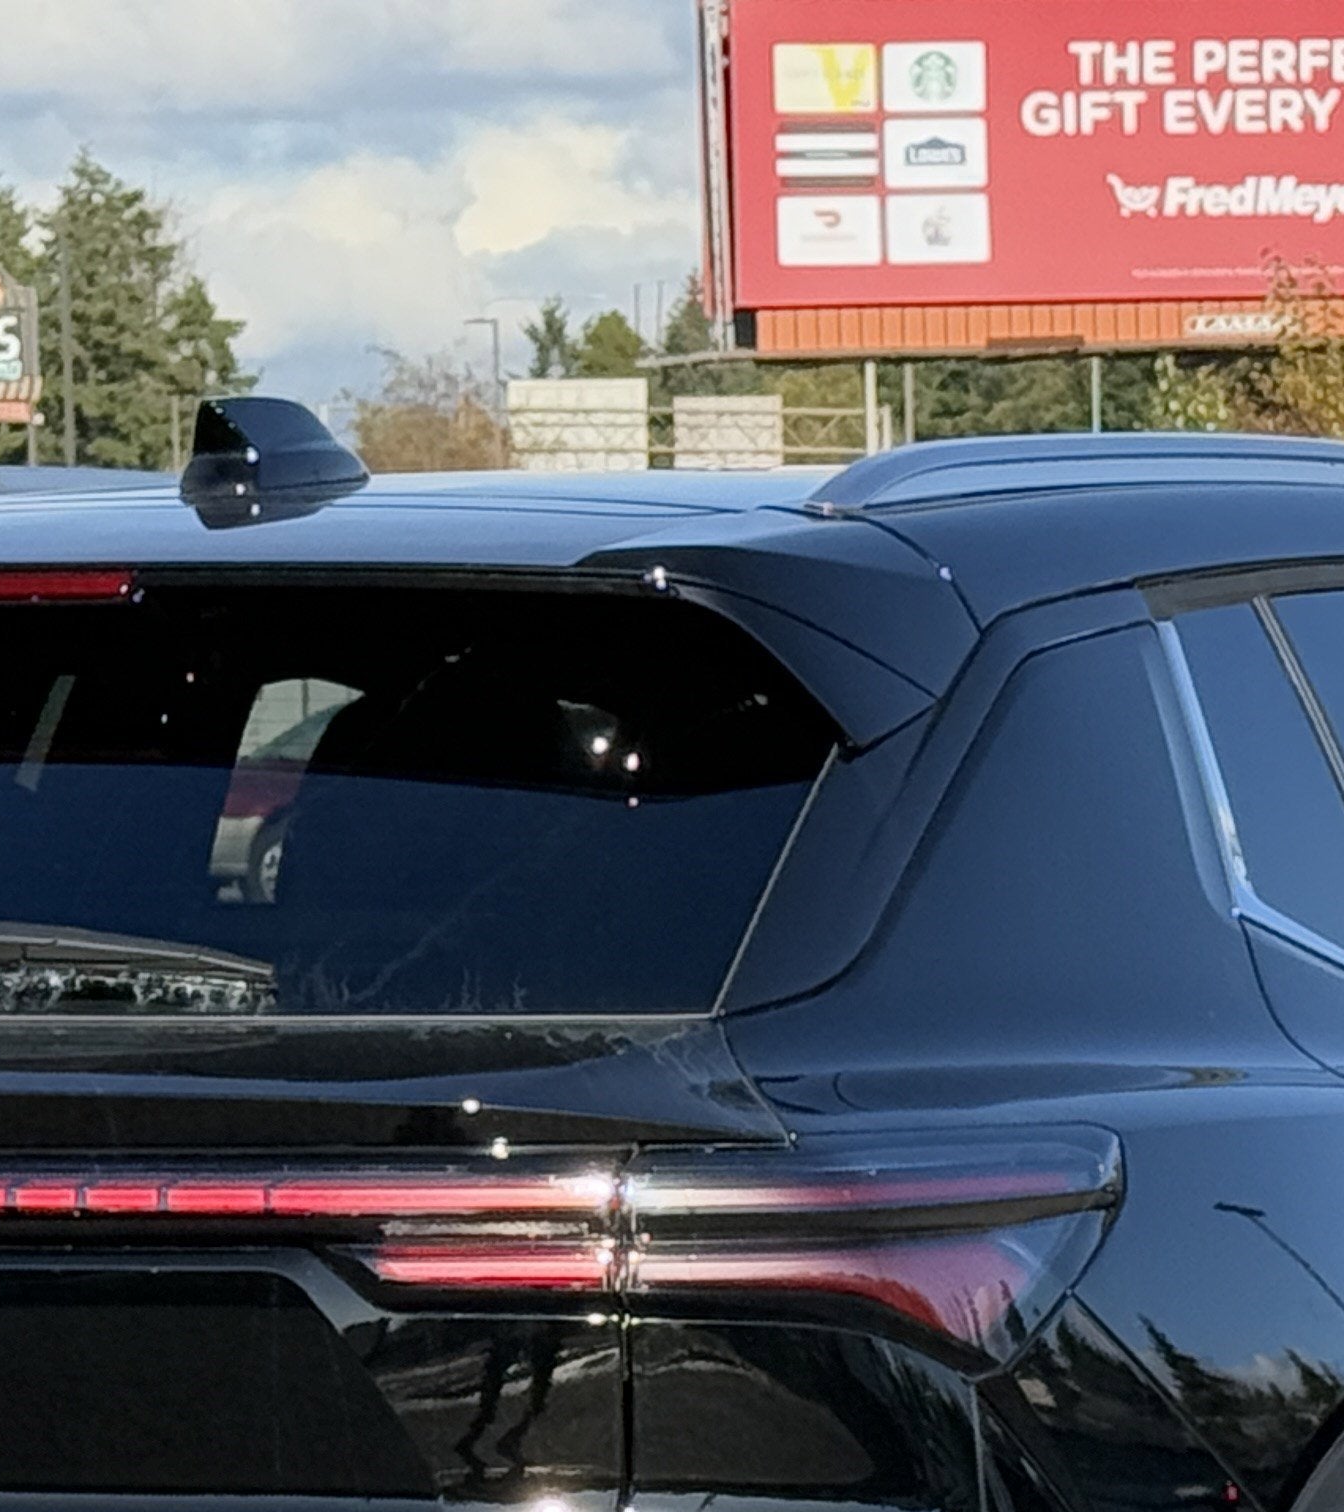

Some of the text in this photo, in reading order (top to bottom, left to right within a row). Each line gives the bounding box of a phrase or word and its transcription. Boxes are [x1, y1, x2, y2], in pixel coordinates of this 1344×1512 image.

[1067, 40, 1176, 86] THE
[1021, 89, 1148, 136] GIFT
[1163, 87, 1341, 135] EVERY
